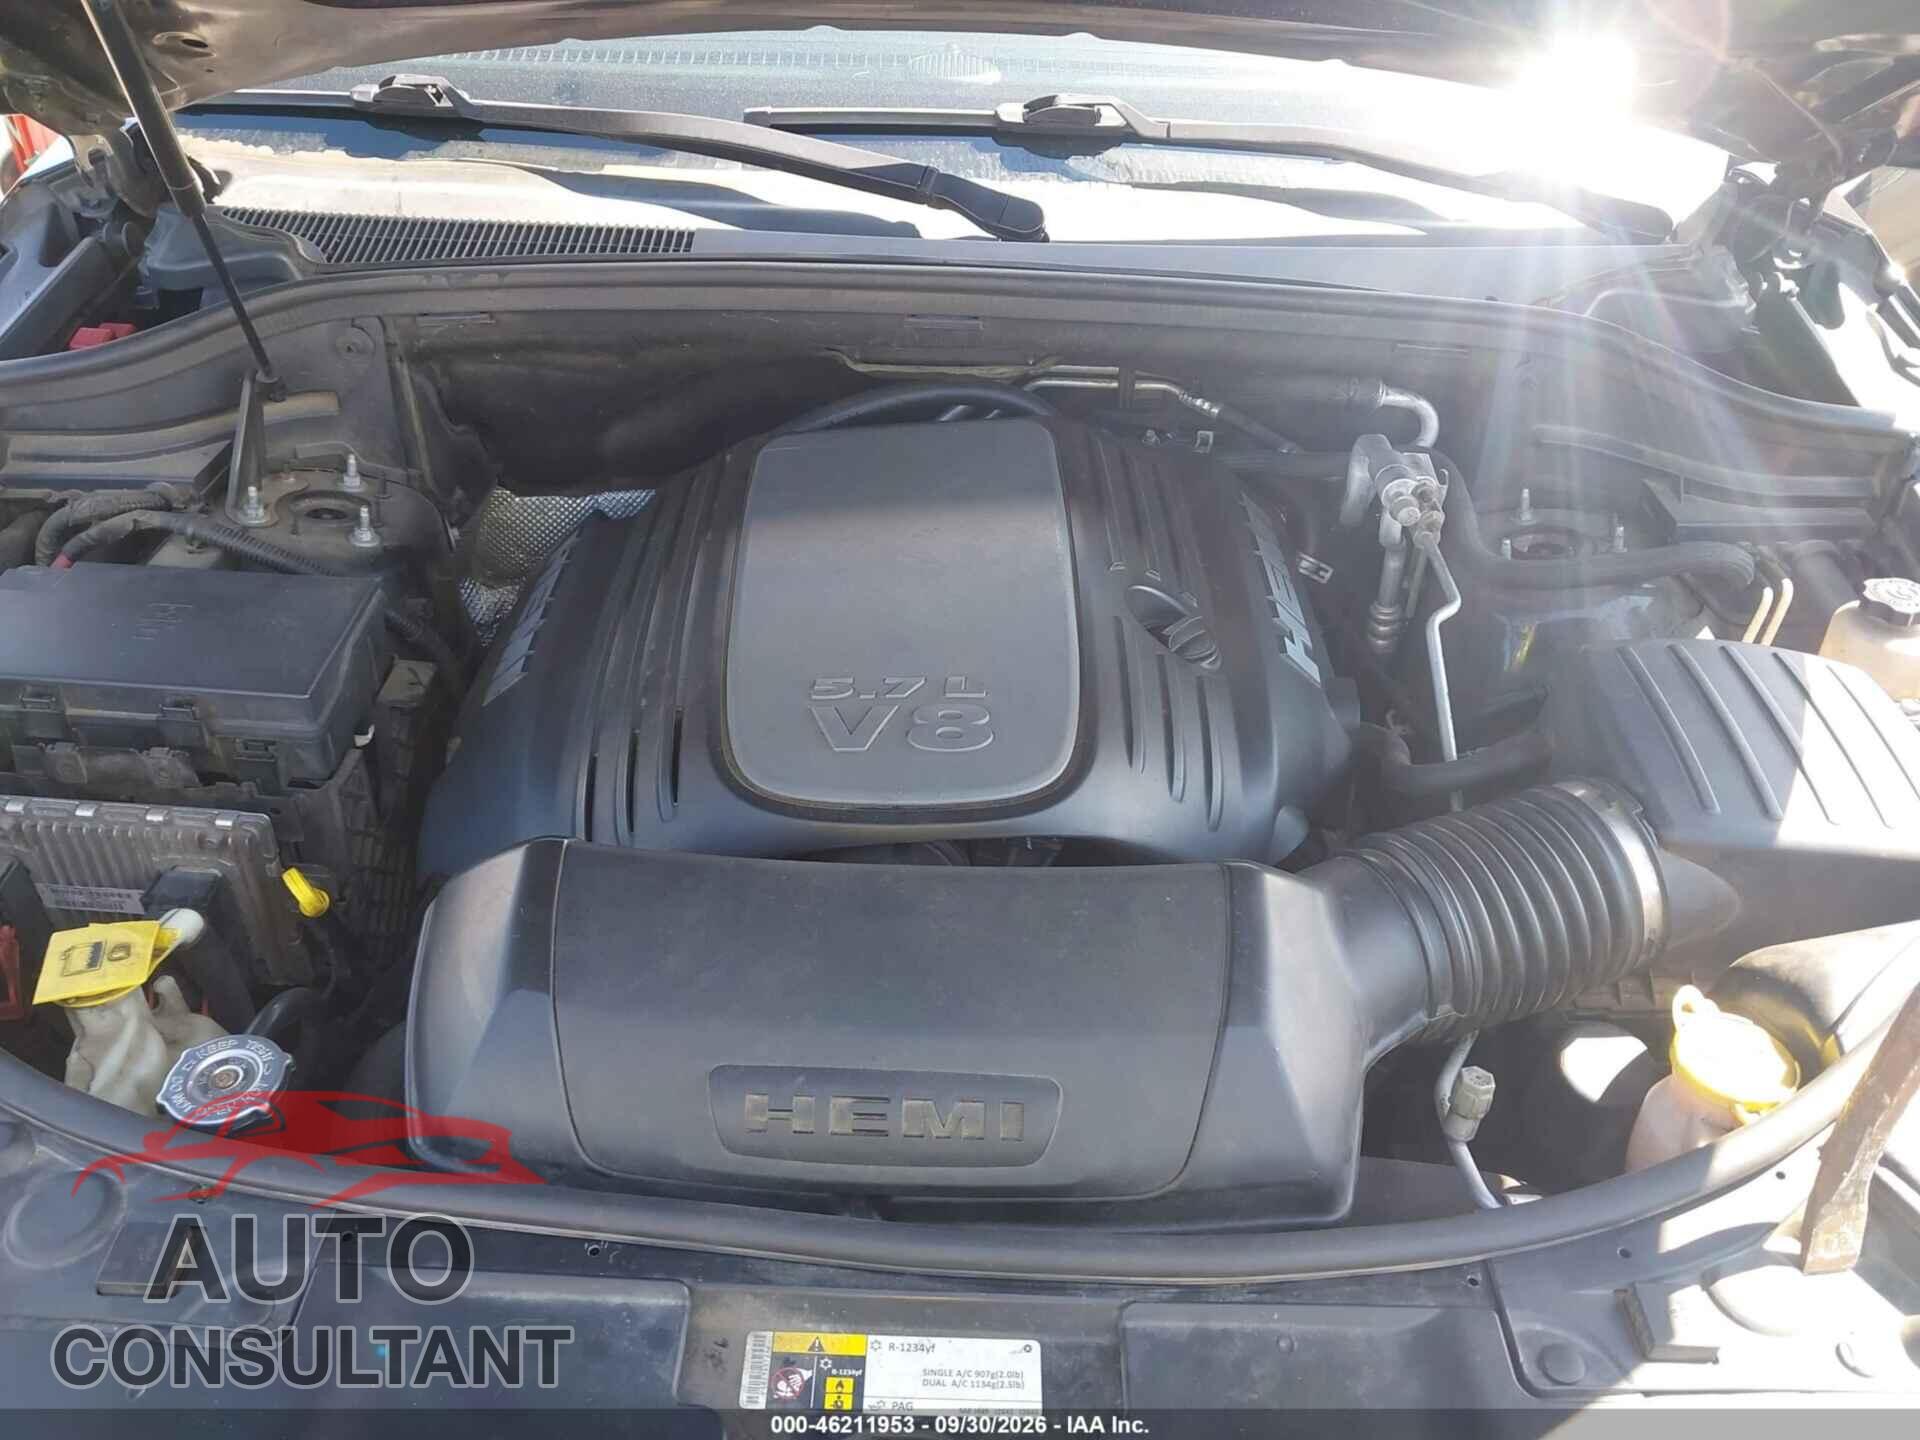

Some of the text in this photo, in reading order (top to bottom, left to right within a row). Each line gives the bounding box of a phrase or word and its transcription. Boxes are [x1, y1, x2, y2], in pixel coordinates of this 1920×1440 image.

[808, 703, 995, 752] V8
[196, 1040, 238, 1059] KEEP
[744, 1093, 1025, 1142] HEMI
[888, 1342, 936, 1355] R-1234yf
[922, 1368, 953, 1378] SINGLE
[955, 1369, 973, 1379] A/C
[922, 1378, 947, 1388] DUAL
[951, 1379, 969, 1389] A/C
[891, 1401, 913, 1412] PAG
